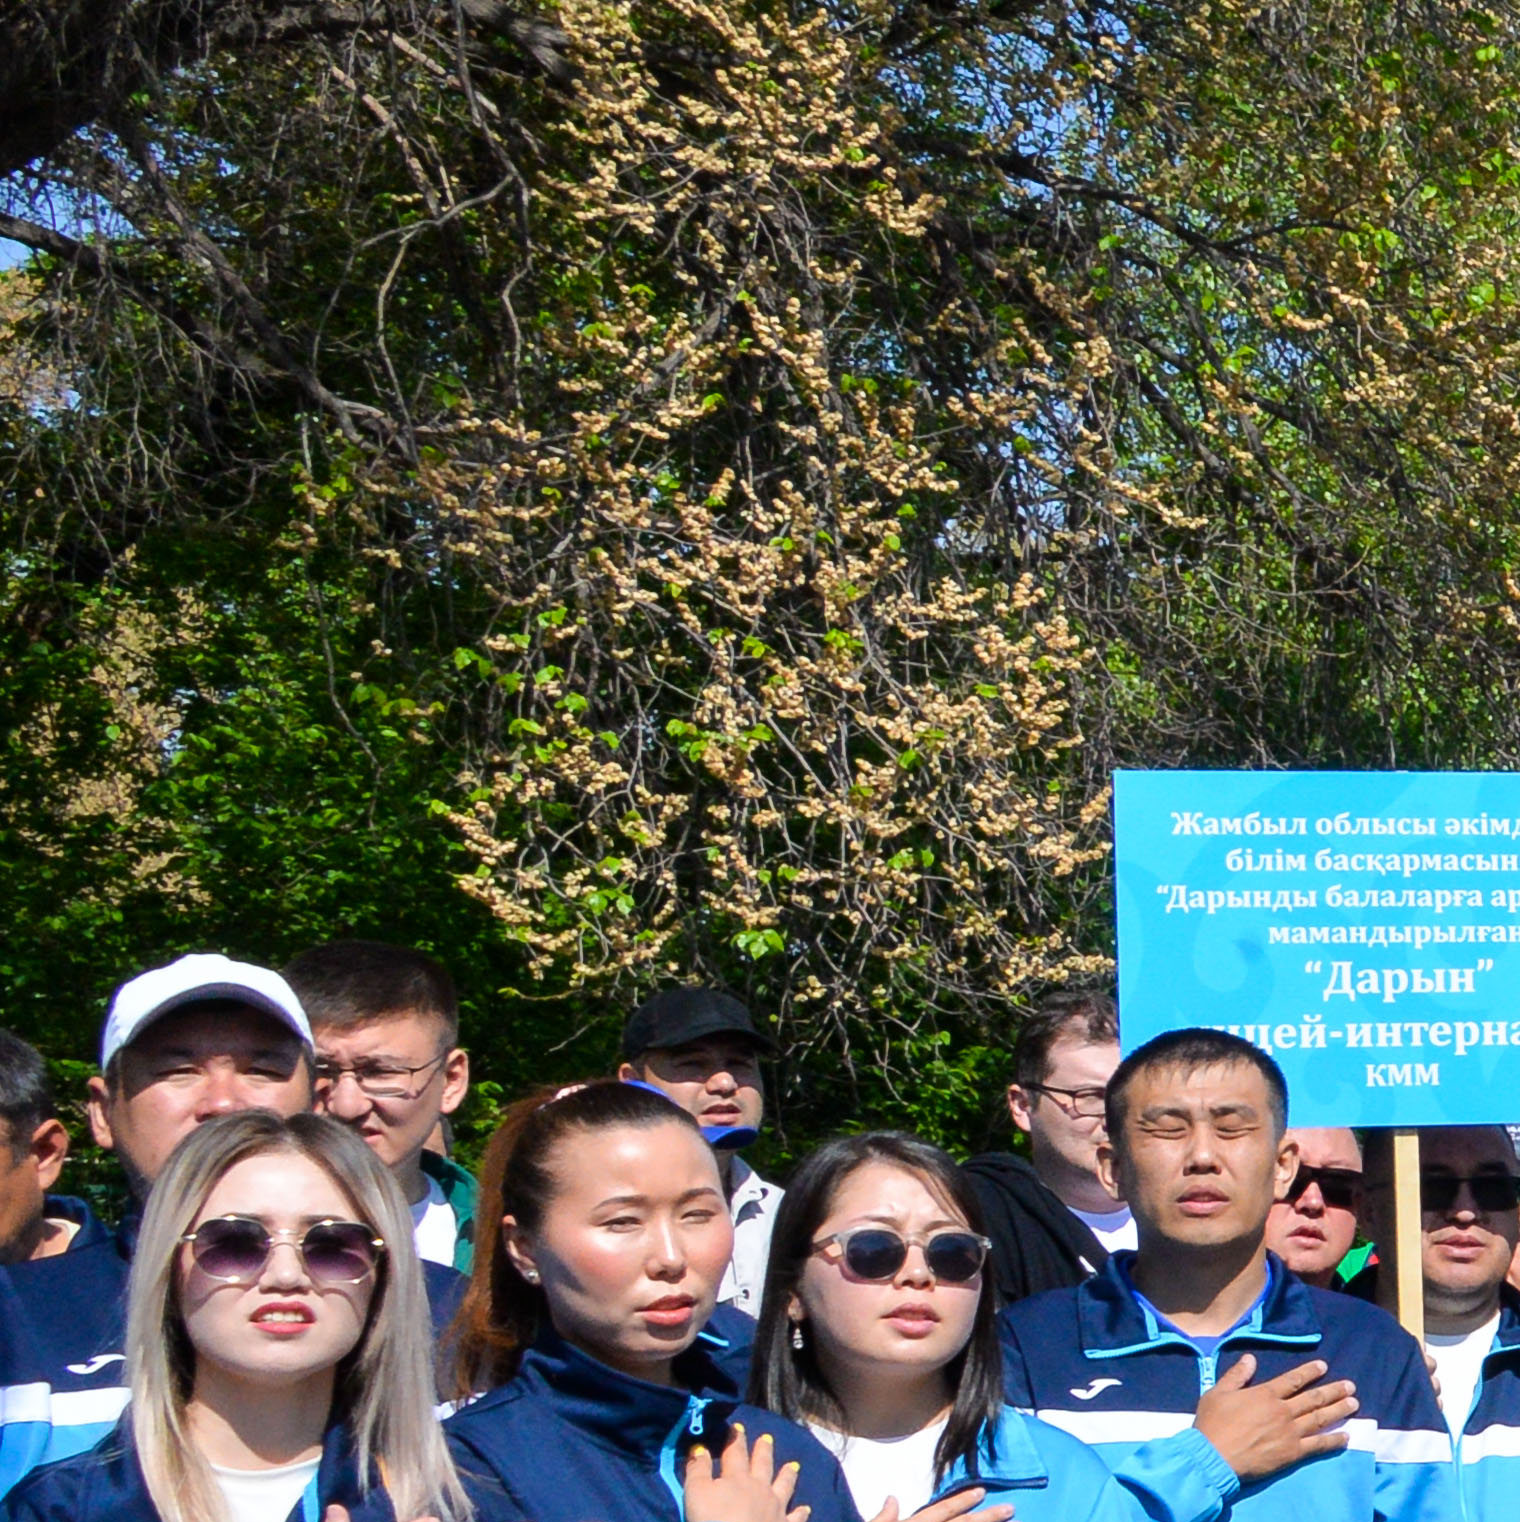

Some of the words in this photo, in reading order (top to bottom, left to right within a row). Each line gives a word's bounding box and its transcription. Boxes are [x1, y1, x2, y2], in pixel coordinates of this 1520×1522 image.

[1171, 812, 1307, 835] Жамбыл
[1315, 812, 1436, 836] облысы
[1225, 848, 1307, 871] білім
[1156, 884, 1317, 914] “Дарынды
[1325, 884, 1483, 913] балаларға
[1304, 958, 1494, 1002] “Дарын”
